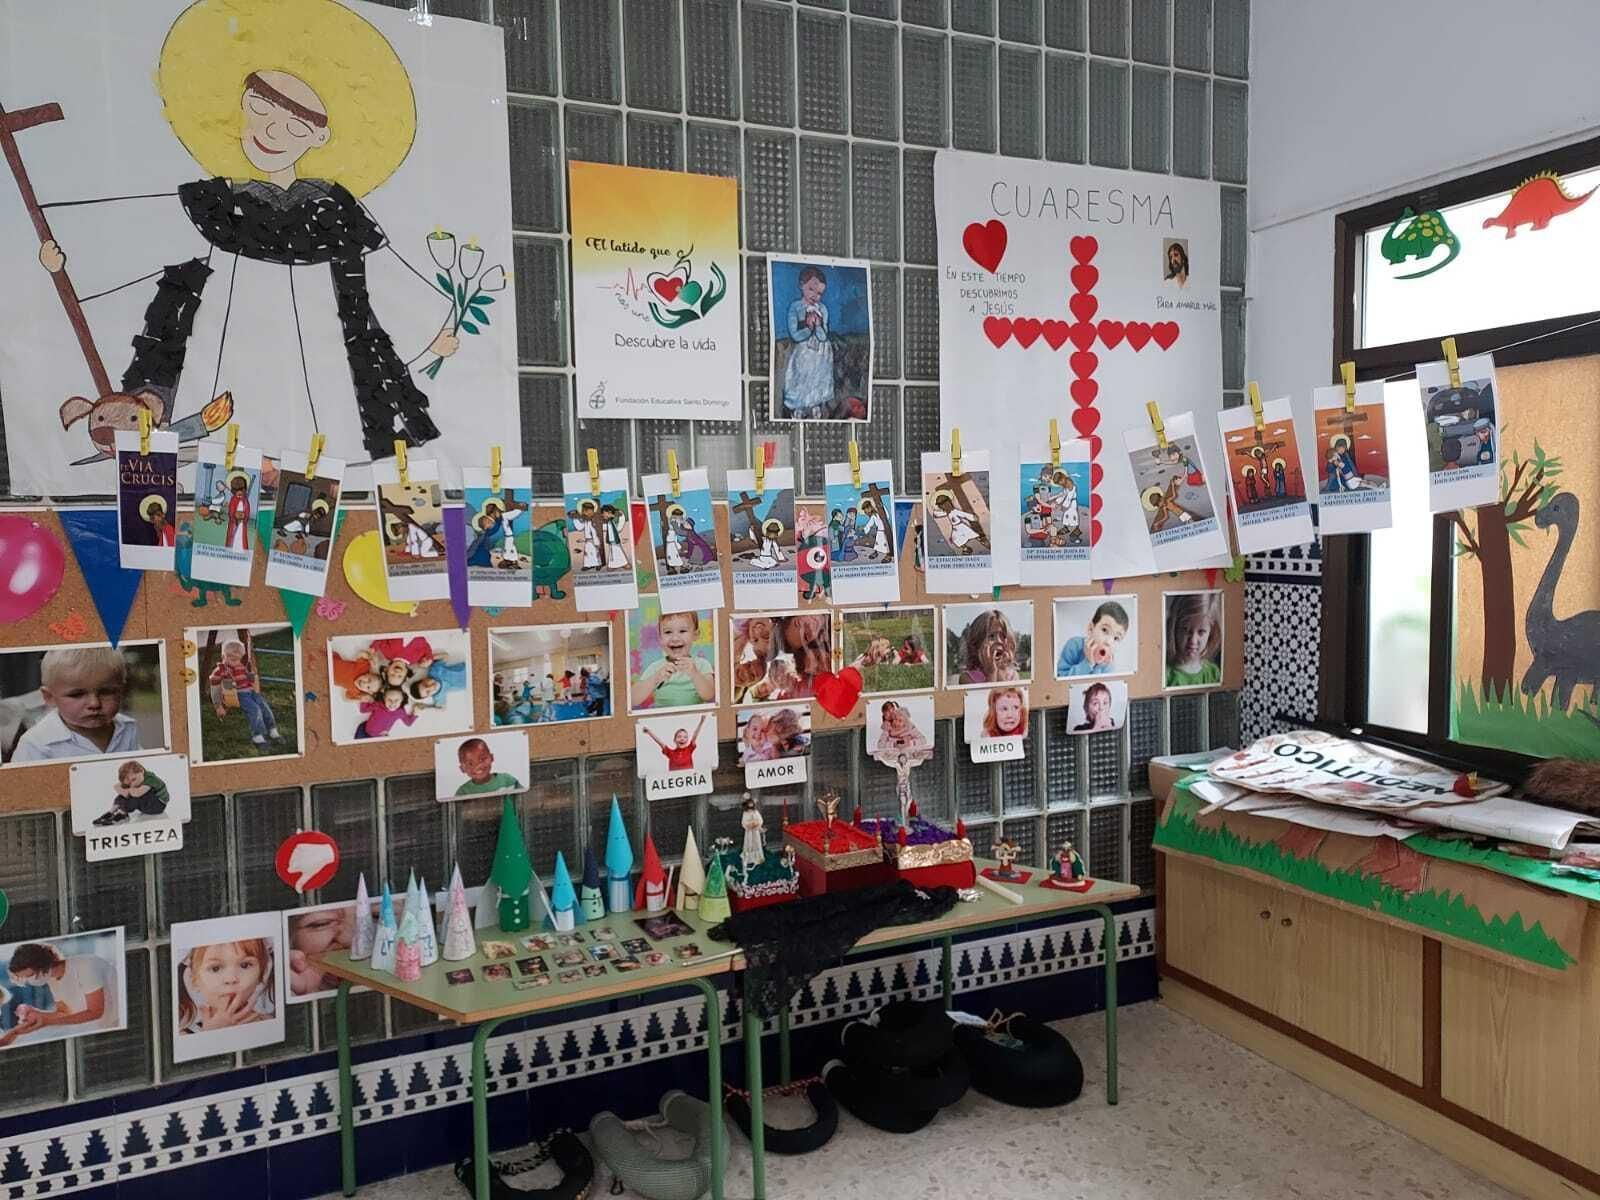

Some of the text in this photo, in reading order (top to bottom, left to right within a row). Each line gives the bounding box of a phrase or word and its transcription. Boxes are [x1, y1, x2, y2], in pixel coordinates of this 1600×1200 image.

[990, 181, 1174, 229] CUARESMA
[586, 237, 671, 259] El latido que
[961, 271, 985, 283] ESTE
[995, 271, 1026, 284] TIEMPO
[960, 288, 1018, 301] DESCUBRIMOS
[969, 301, 1015, 316] A JESÚS
[614, 333, 717, 352] Descubre la vida
[121, 472, 175, 486] CRUCIS
[979, 742, 1014, 755] MIEDO
[757, 764, 795, 778] AMOR
[651, 772, 707, 792] ALEGRÍA
[90, 828, 178, 851] TRISTEZA
